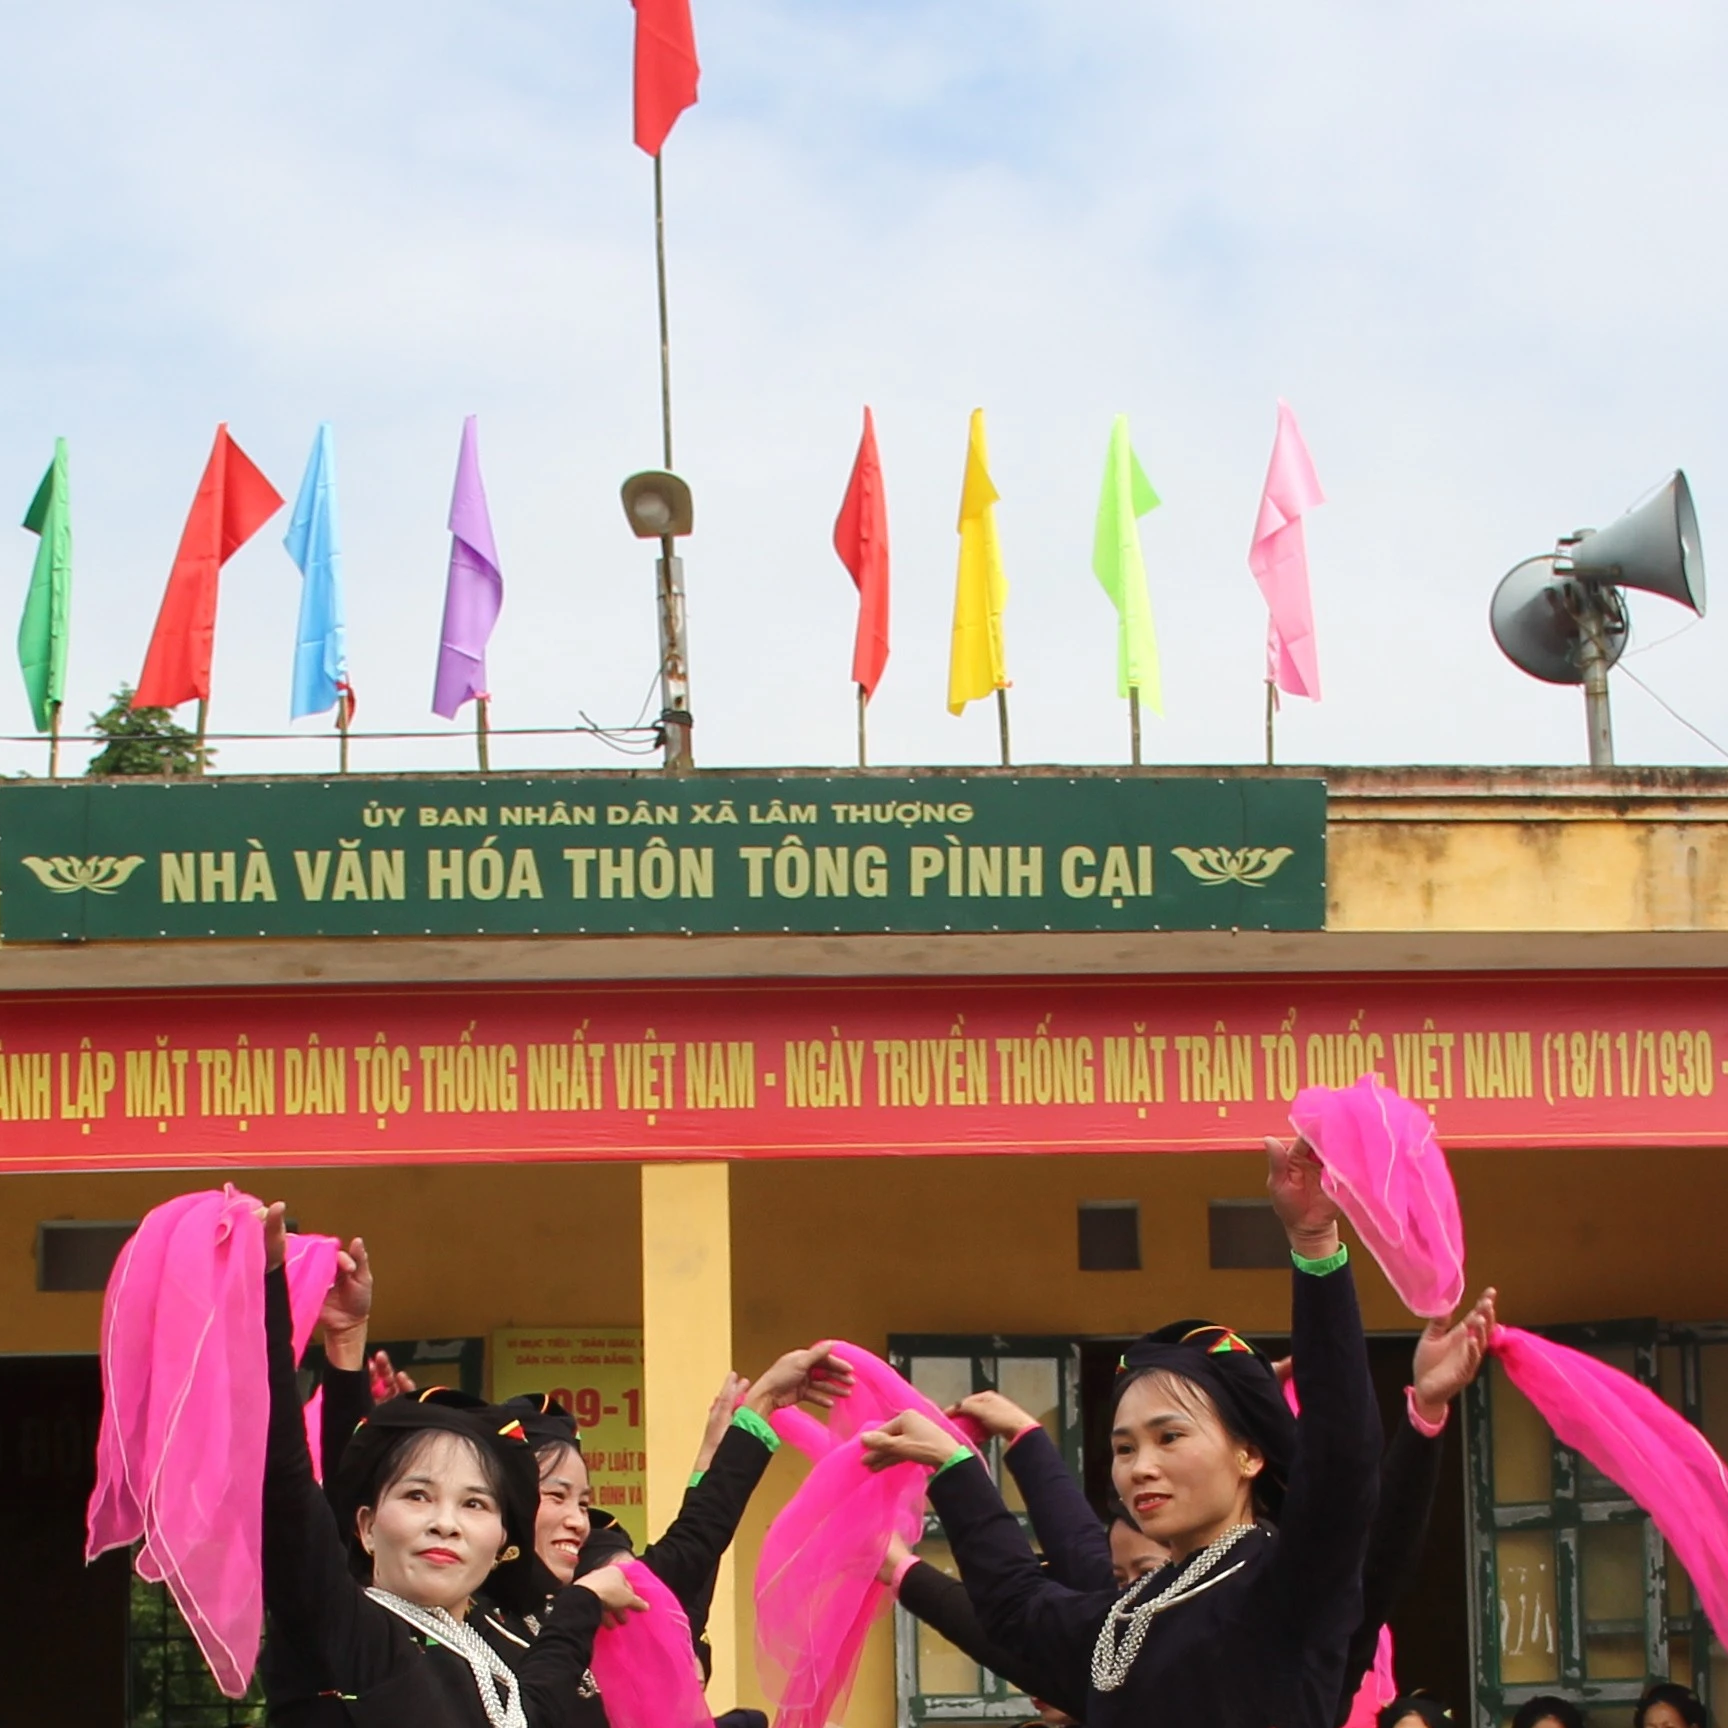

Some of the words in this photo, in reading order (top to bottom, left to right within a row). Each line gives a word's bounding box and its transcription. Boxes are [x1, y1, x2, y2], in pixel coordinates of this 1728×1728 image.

[362, 799, 405, 827] ỦY
[419, 805, 487, 826] BAN
[499, 800, 596, 826] NHÂN
[606, 799, 678, 825] DÂN
[690, 799, 738, 824] XÃ
[749, 799, 818, 823] LÂM
[831, 799, 975, 828] THƯỢNG
[160, 838, 276, 903] NHÀ
[293, 838, 405, 901] VĂN
[427, 835, 543, 900] HÓA
[563, 836, 714, 899] THÔN
[739, 834, 888, 898] TÔNG
[910, 833, 1043, 897] PÌNH
[1061, 845, 1153, 909] CẠI
[60, 1037, 116, 1135] LẬP
[124, 1035, 190, 1133] MẶT
[196, 1034, 276, 1132] TRẬN
[284, 1032, 347, 1116] DÂN
[353, 1031, 412, 1130] TỘC
[418, 1021, 520, 1114] THỐNG
[526, 1019, 606, 1112] NHẤT
[613, 1028, 677, 1126] VIỆT
[684, 1041, 757, 1110] NAM
[784, 1025, 865, 1109] NGÀY
[872, 1014, 990, 1108] TRUYỀN
[995, 1013, 1097, 1106] THỐNG
[1102, 1022, 1168, 1120] MẶT
[1173, 1021, 1255, 1118] TRẬN
[1259, 1007, 1300, 1103] TỔ
[1305, 1009, 1387, 1092] QUỐC
[1391, 1018, 1457, 1116] VIỆT
[1462, 1031, 1535, 1100] NAM
[1541, 1029, 1716, 1105] (18/11/1930
